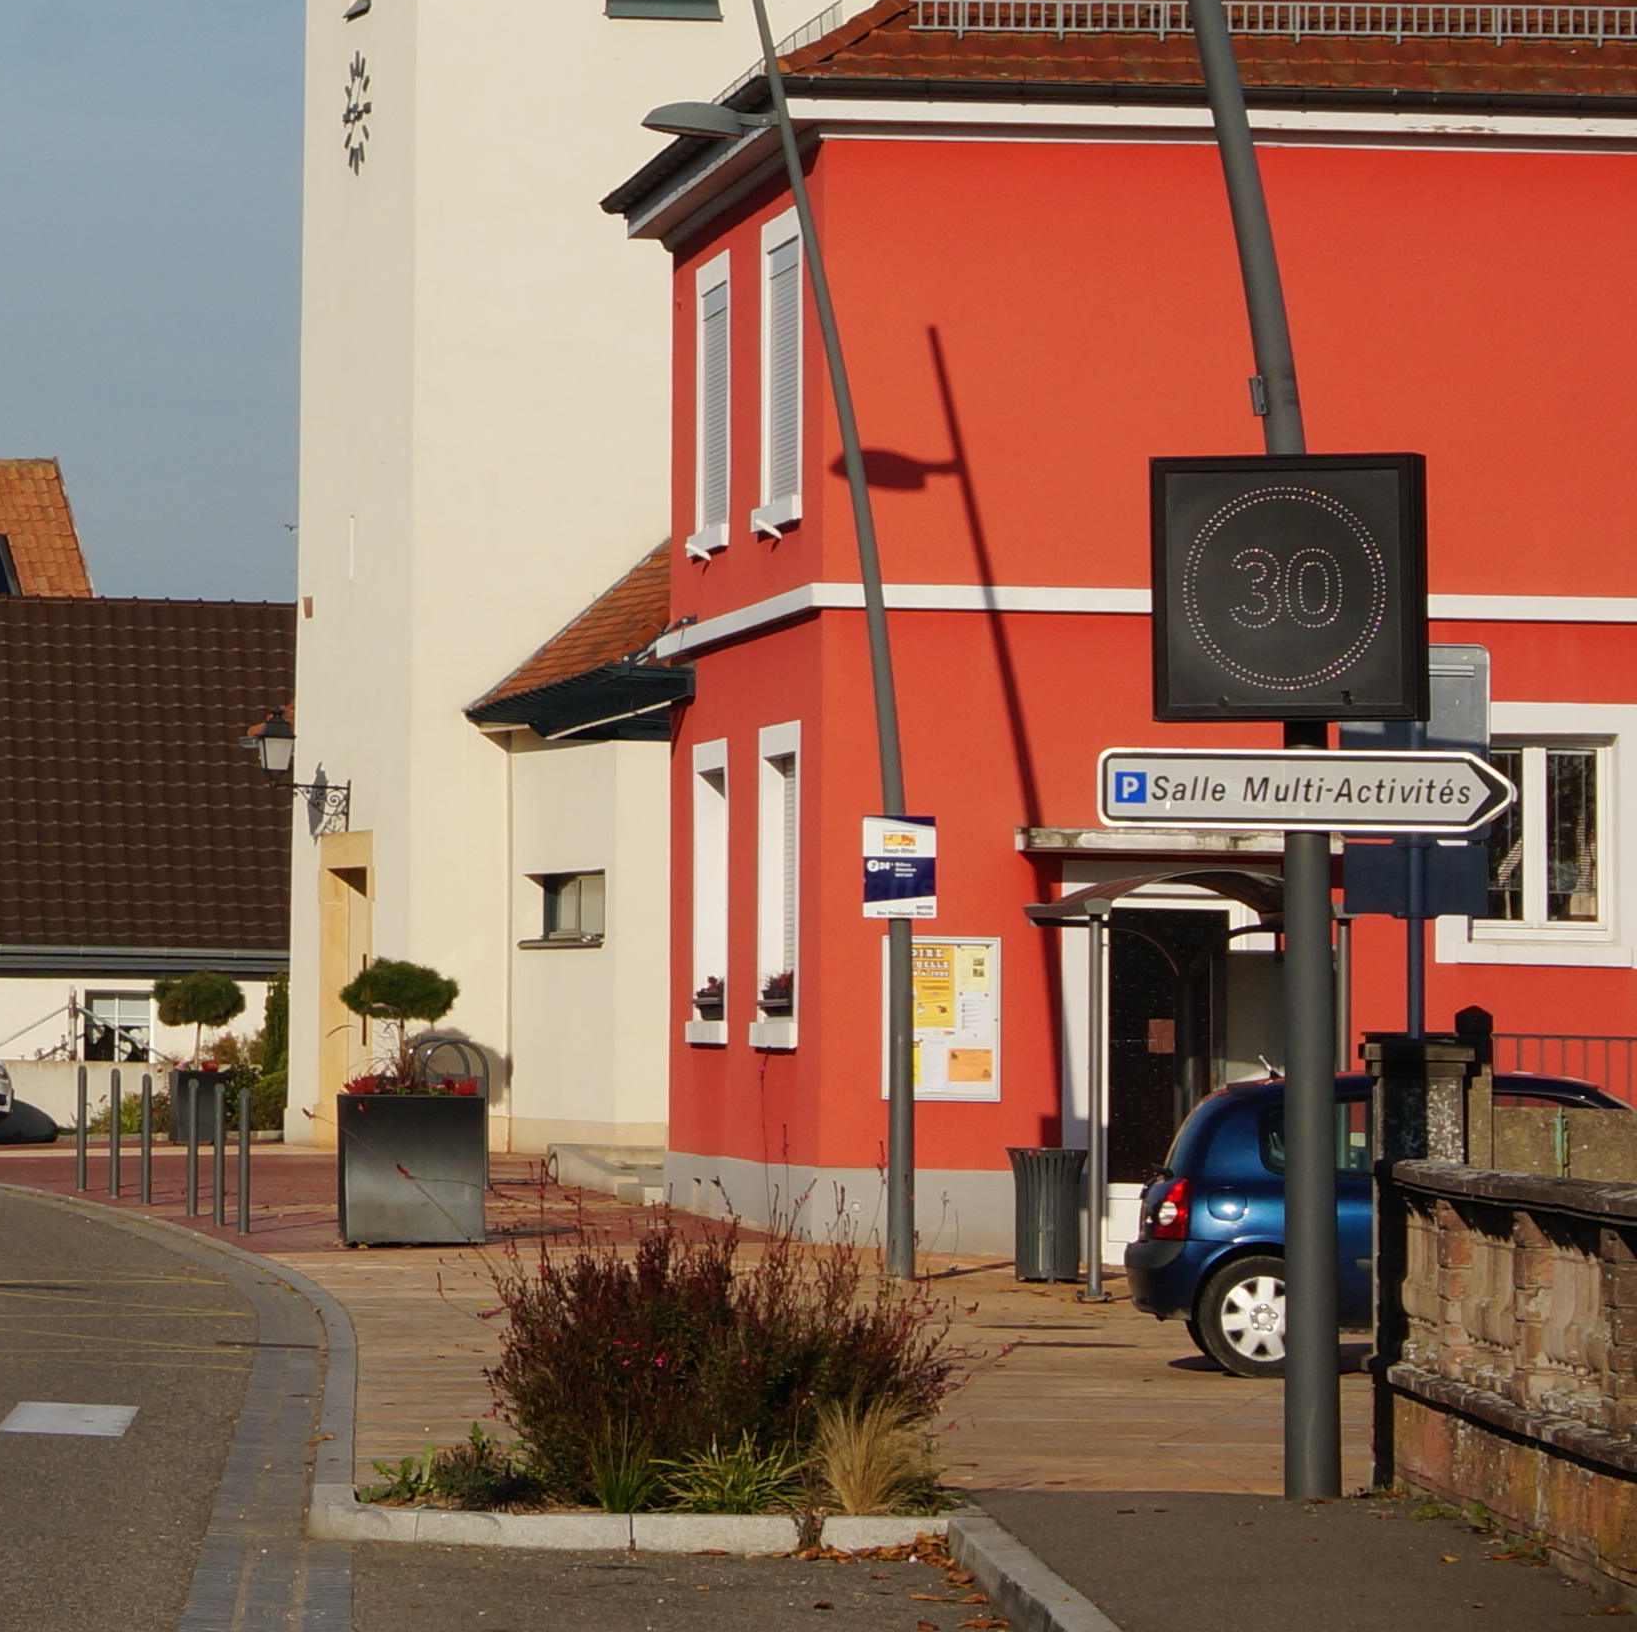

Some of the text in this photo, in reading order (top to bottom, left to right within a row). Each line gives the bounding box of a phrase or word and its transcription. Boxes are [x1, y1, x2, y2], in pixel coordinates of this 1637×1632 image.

[1228, 547, 1343, 629] 30
[1122, 775, 1471, 805] P Salle Multi-Activités
